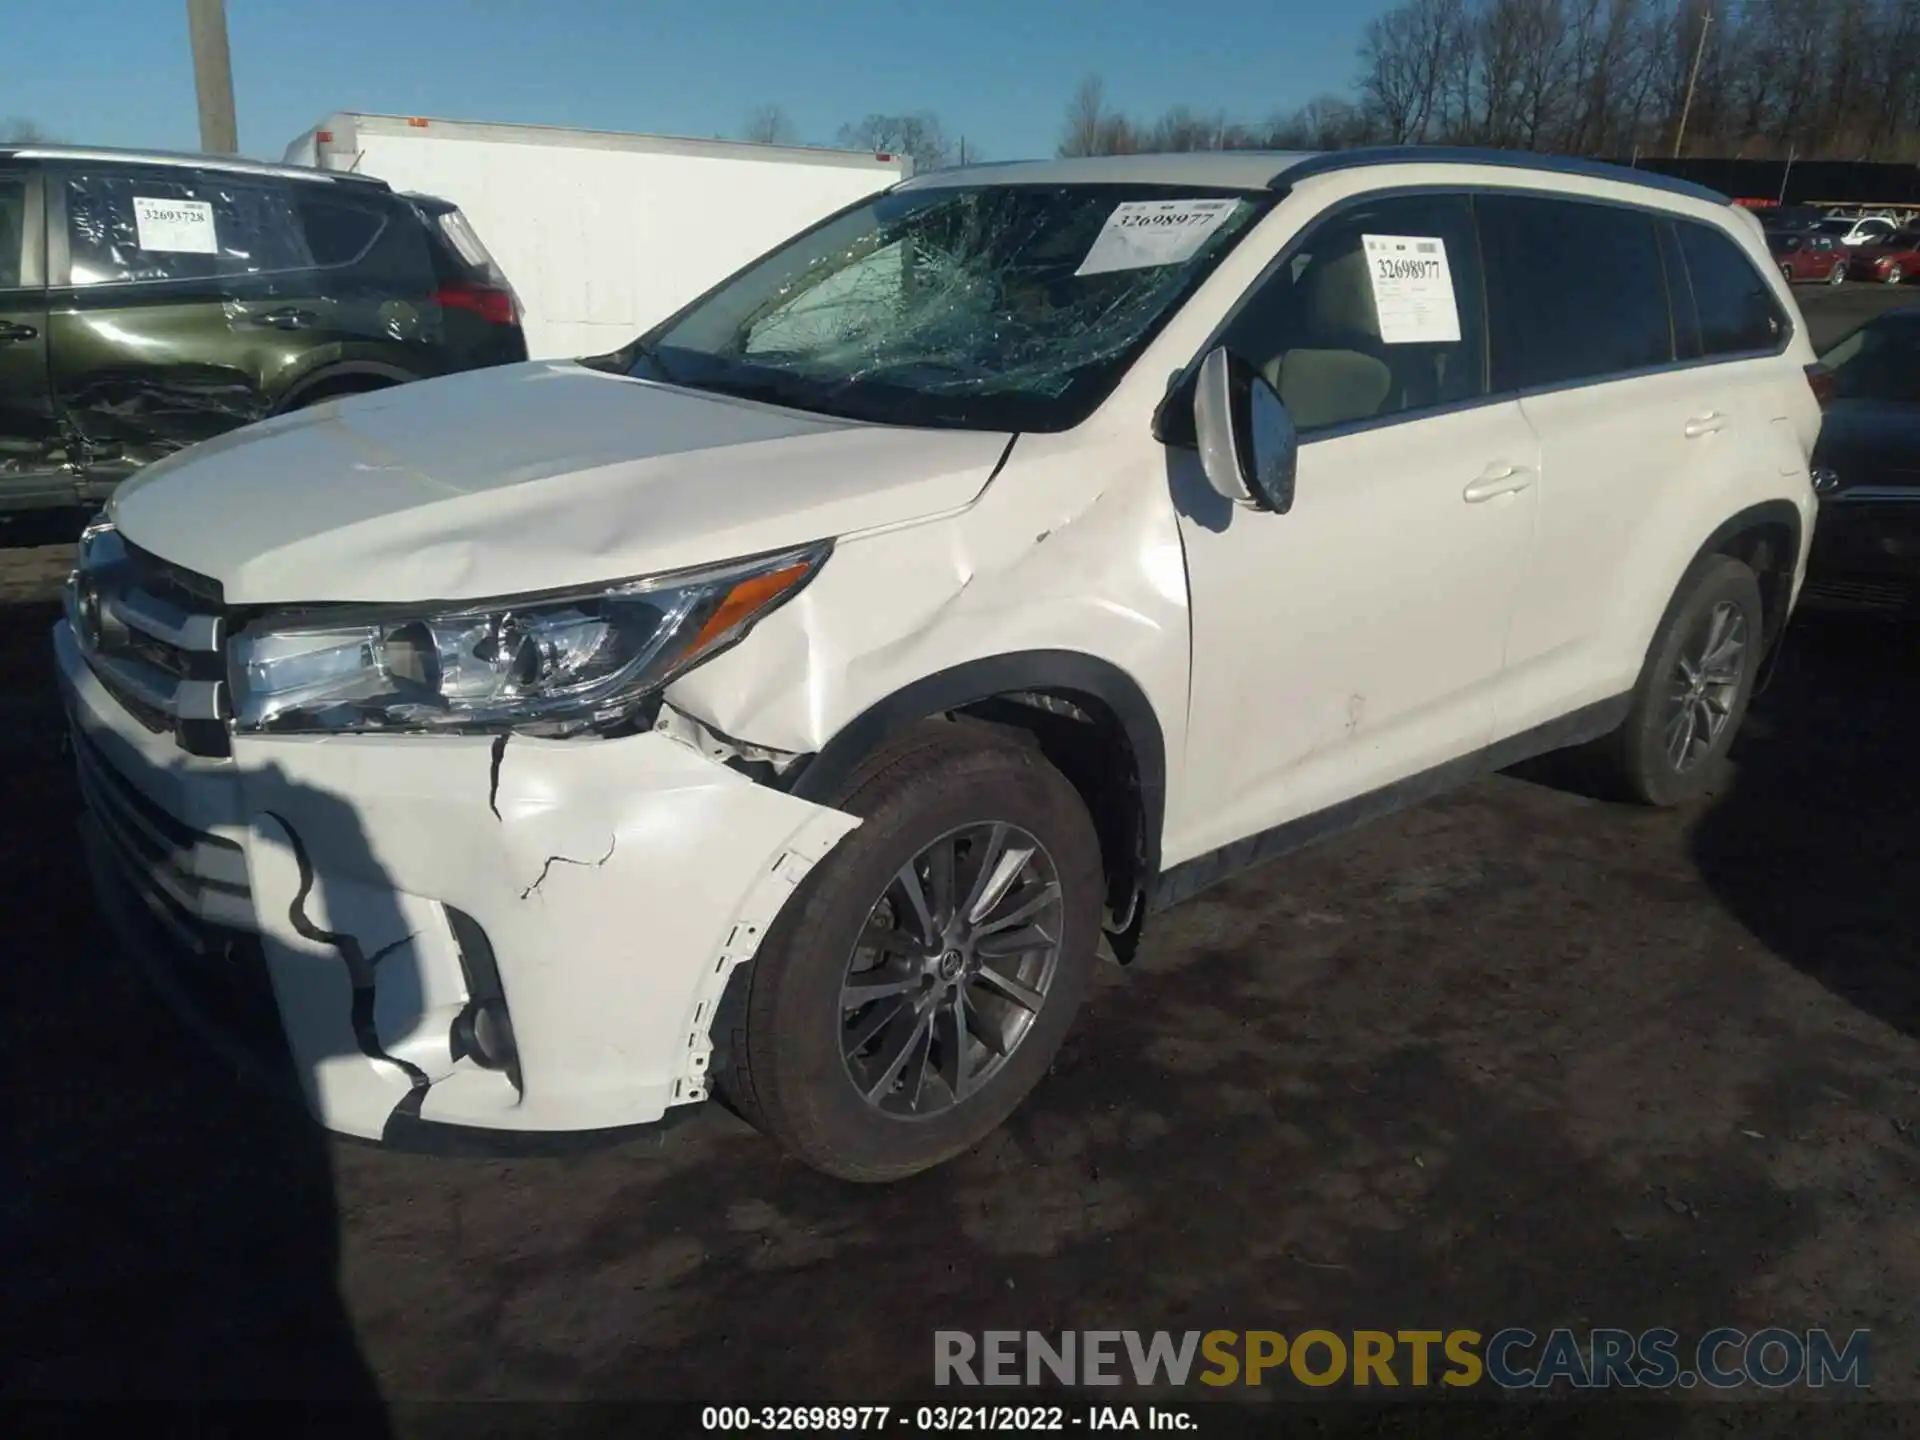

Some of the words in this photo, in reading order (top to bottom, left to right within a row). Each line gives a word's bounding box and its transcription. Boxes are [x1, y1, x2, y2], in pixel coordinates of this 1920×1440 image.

[143, 208, 205, 222] 32693728
[1114, 213, 1215, 228] 32698977
[1378, 258, 1440, 280] 32698977
